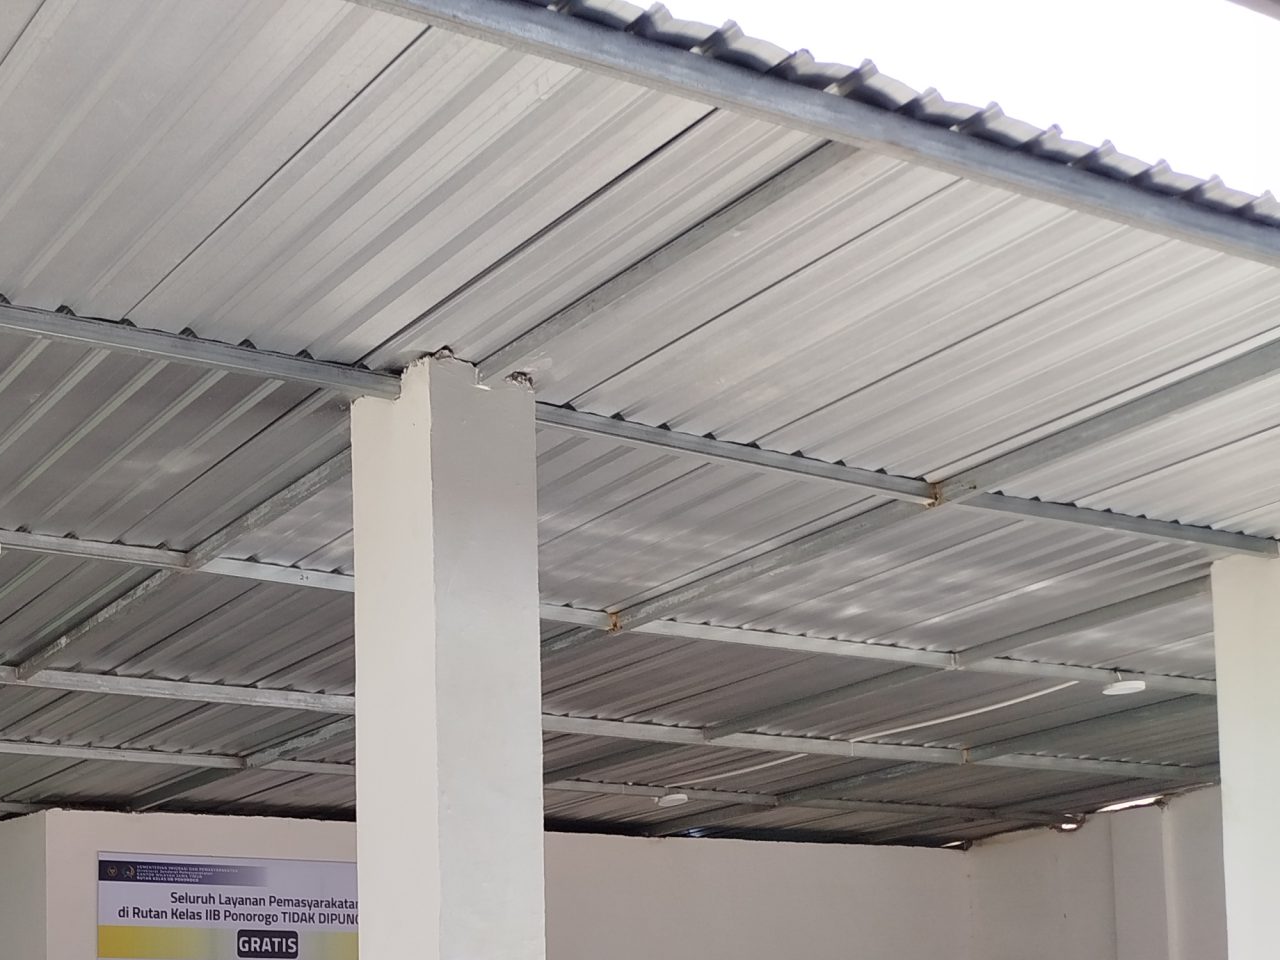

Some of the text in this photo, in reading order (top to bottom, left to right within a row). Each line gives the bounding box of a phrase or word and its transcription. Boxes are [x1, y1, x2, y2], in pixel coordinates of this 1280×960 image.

[170, 892, 216, 905] Seluruh
[218, 893, 266, 908] Layanan
[118, 907, 130, 918] di
[132, 907, 168, 919] Rutan
[171, 908, 202, 920] Kelas
[205, 909, 221, 921] IIB
[223, 910, 279, 926] Ponorogo
[281, 911, 316, 924] TIDAK
[238, 935, 298, 953] GRATIS
